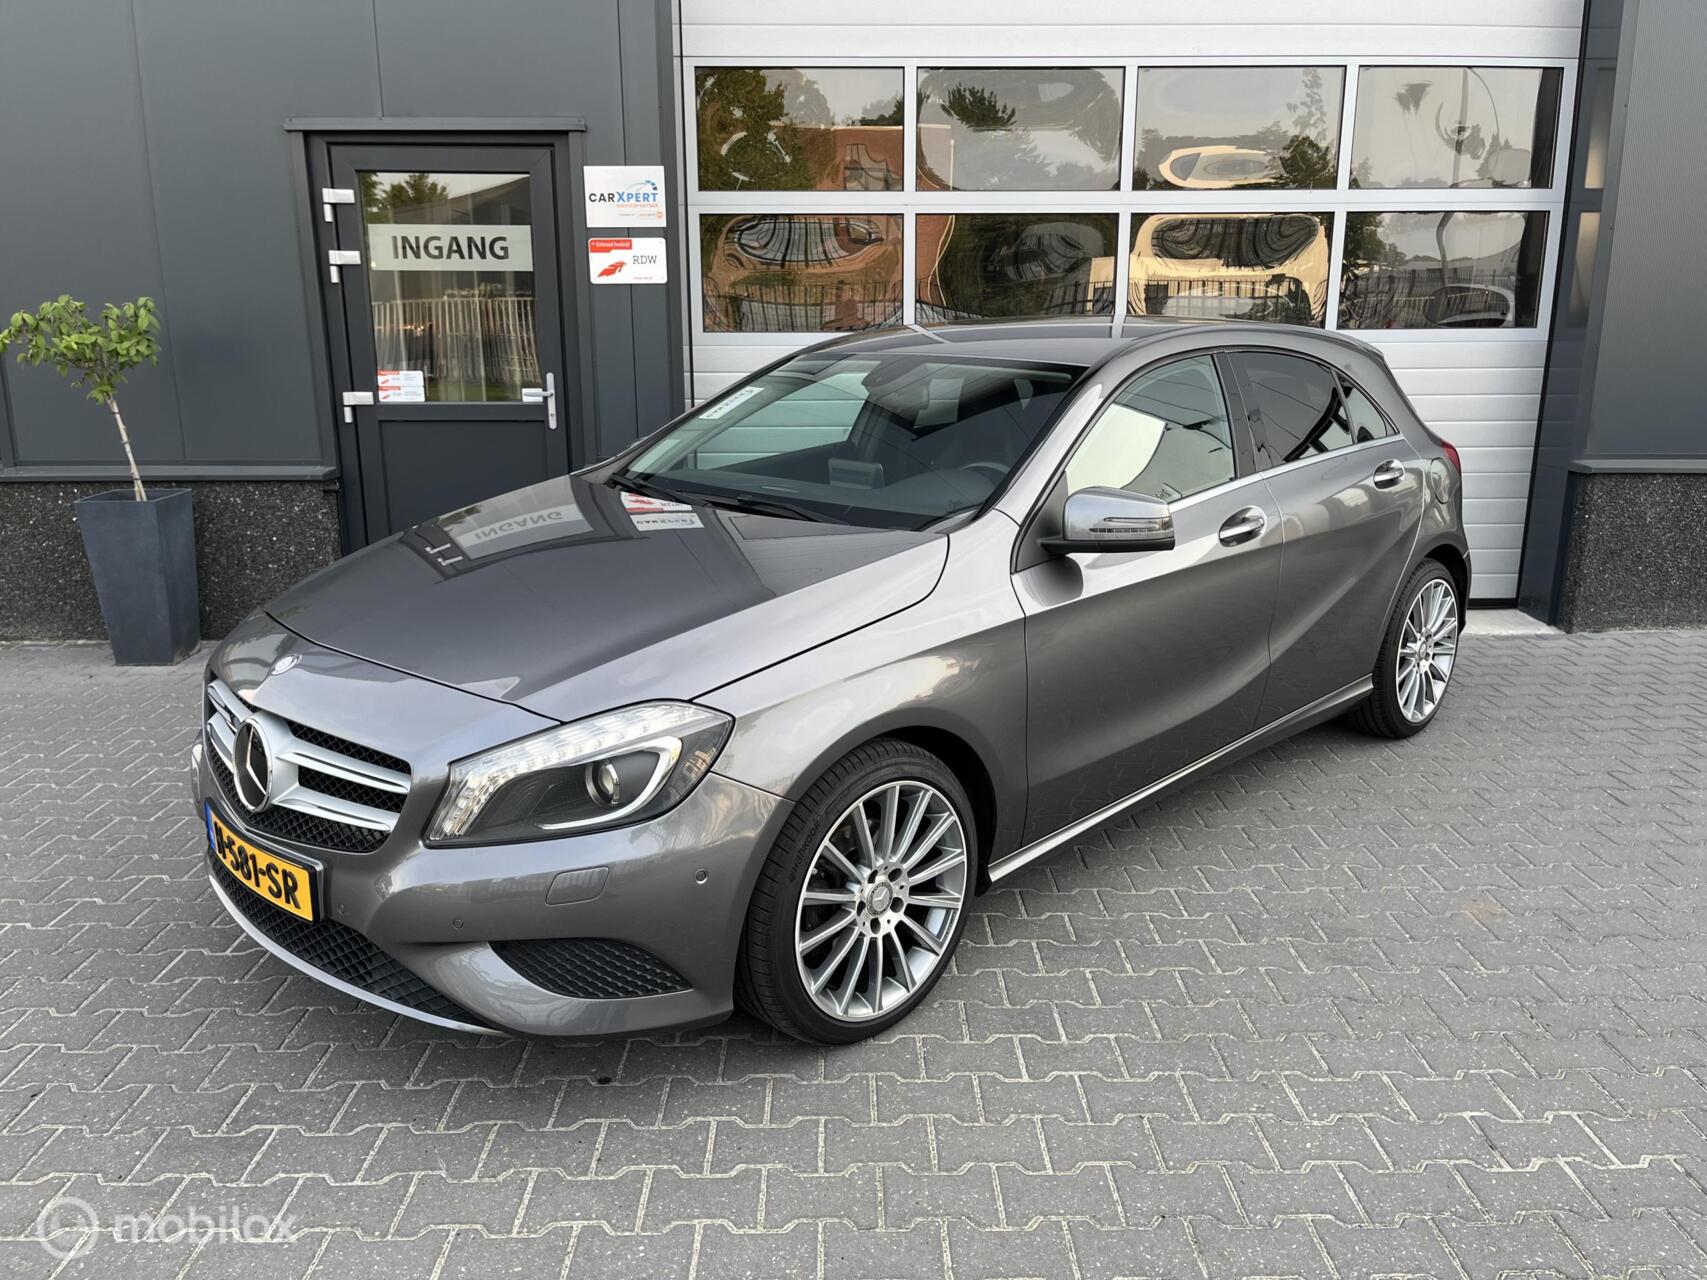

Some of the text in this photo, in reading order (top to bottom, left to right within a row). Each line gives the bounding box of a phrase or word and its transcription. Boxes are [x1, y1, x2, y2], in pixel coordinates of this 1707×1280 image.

[588, 192, 659, 203] CARXPERT
[392, 235, 510, 260] INGANG
[633, 255, 657, 265] RDW
